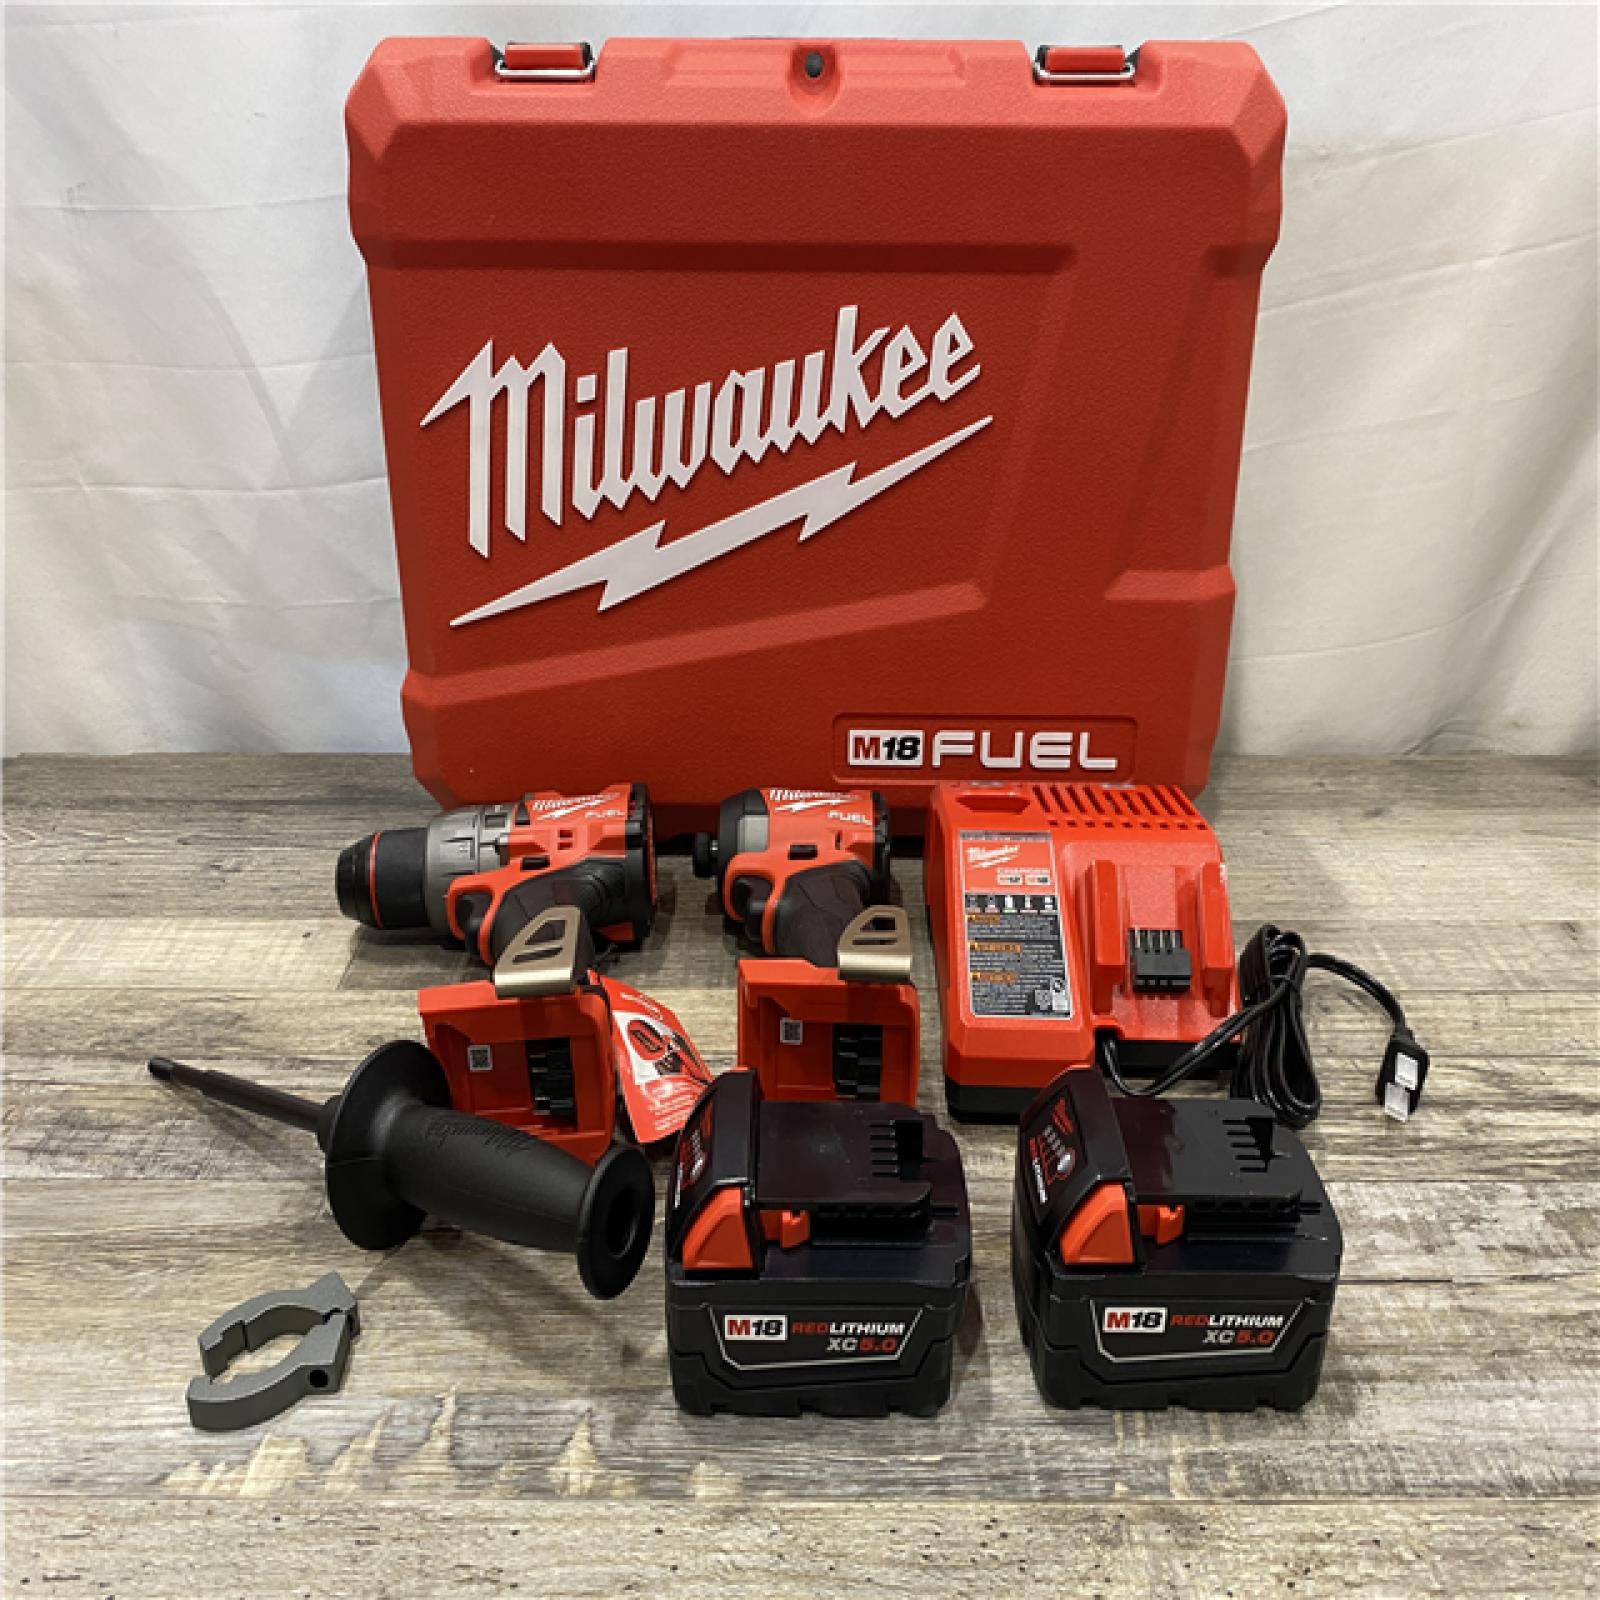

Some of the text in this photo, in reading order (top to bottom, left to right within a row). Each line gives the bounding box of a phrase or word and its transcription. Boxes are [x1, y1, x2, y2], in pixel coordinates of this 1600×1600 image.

[421, 304, 982, 559] Milwaukee
[852, 731, 1118, 769] M18 FUEL
[727, 1318, 784, 1337] M18
[1106, 1310, 1164, 1330] M18
